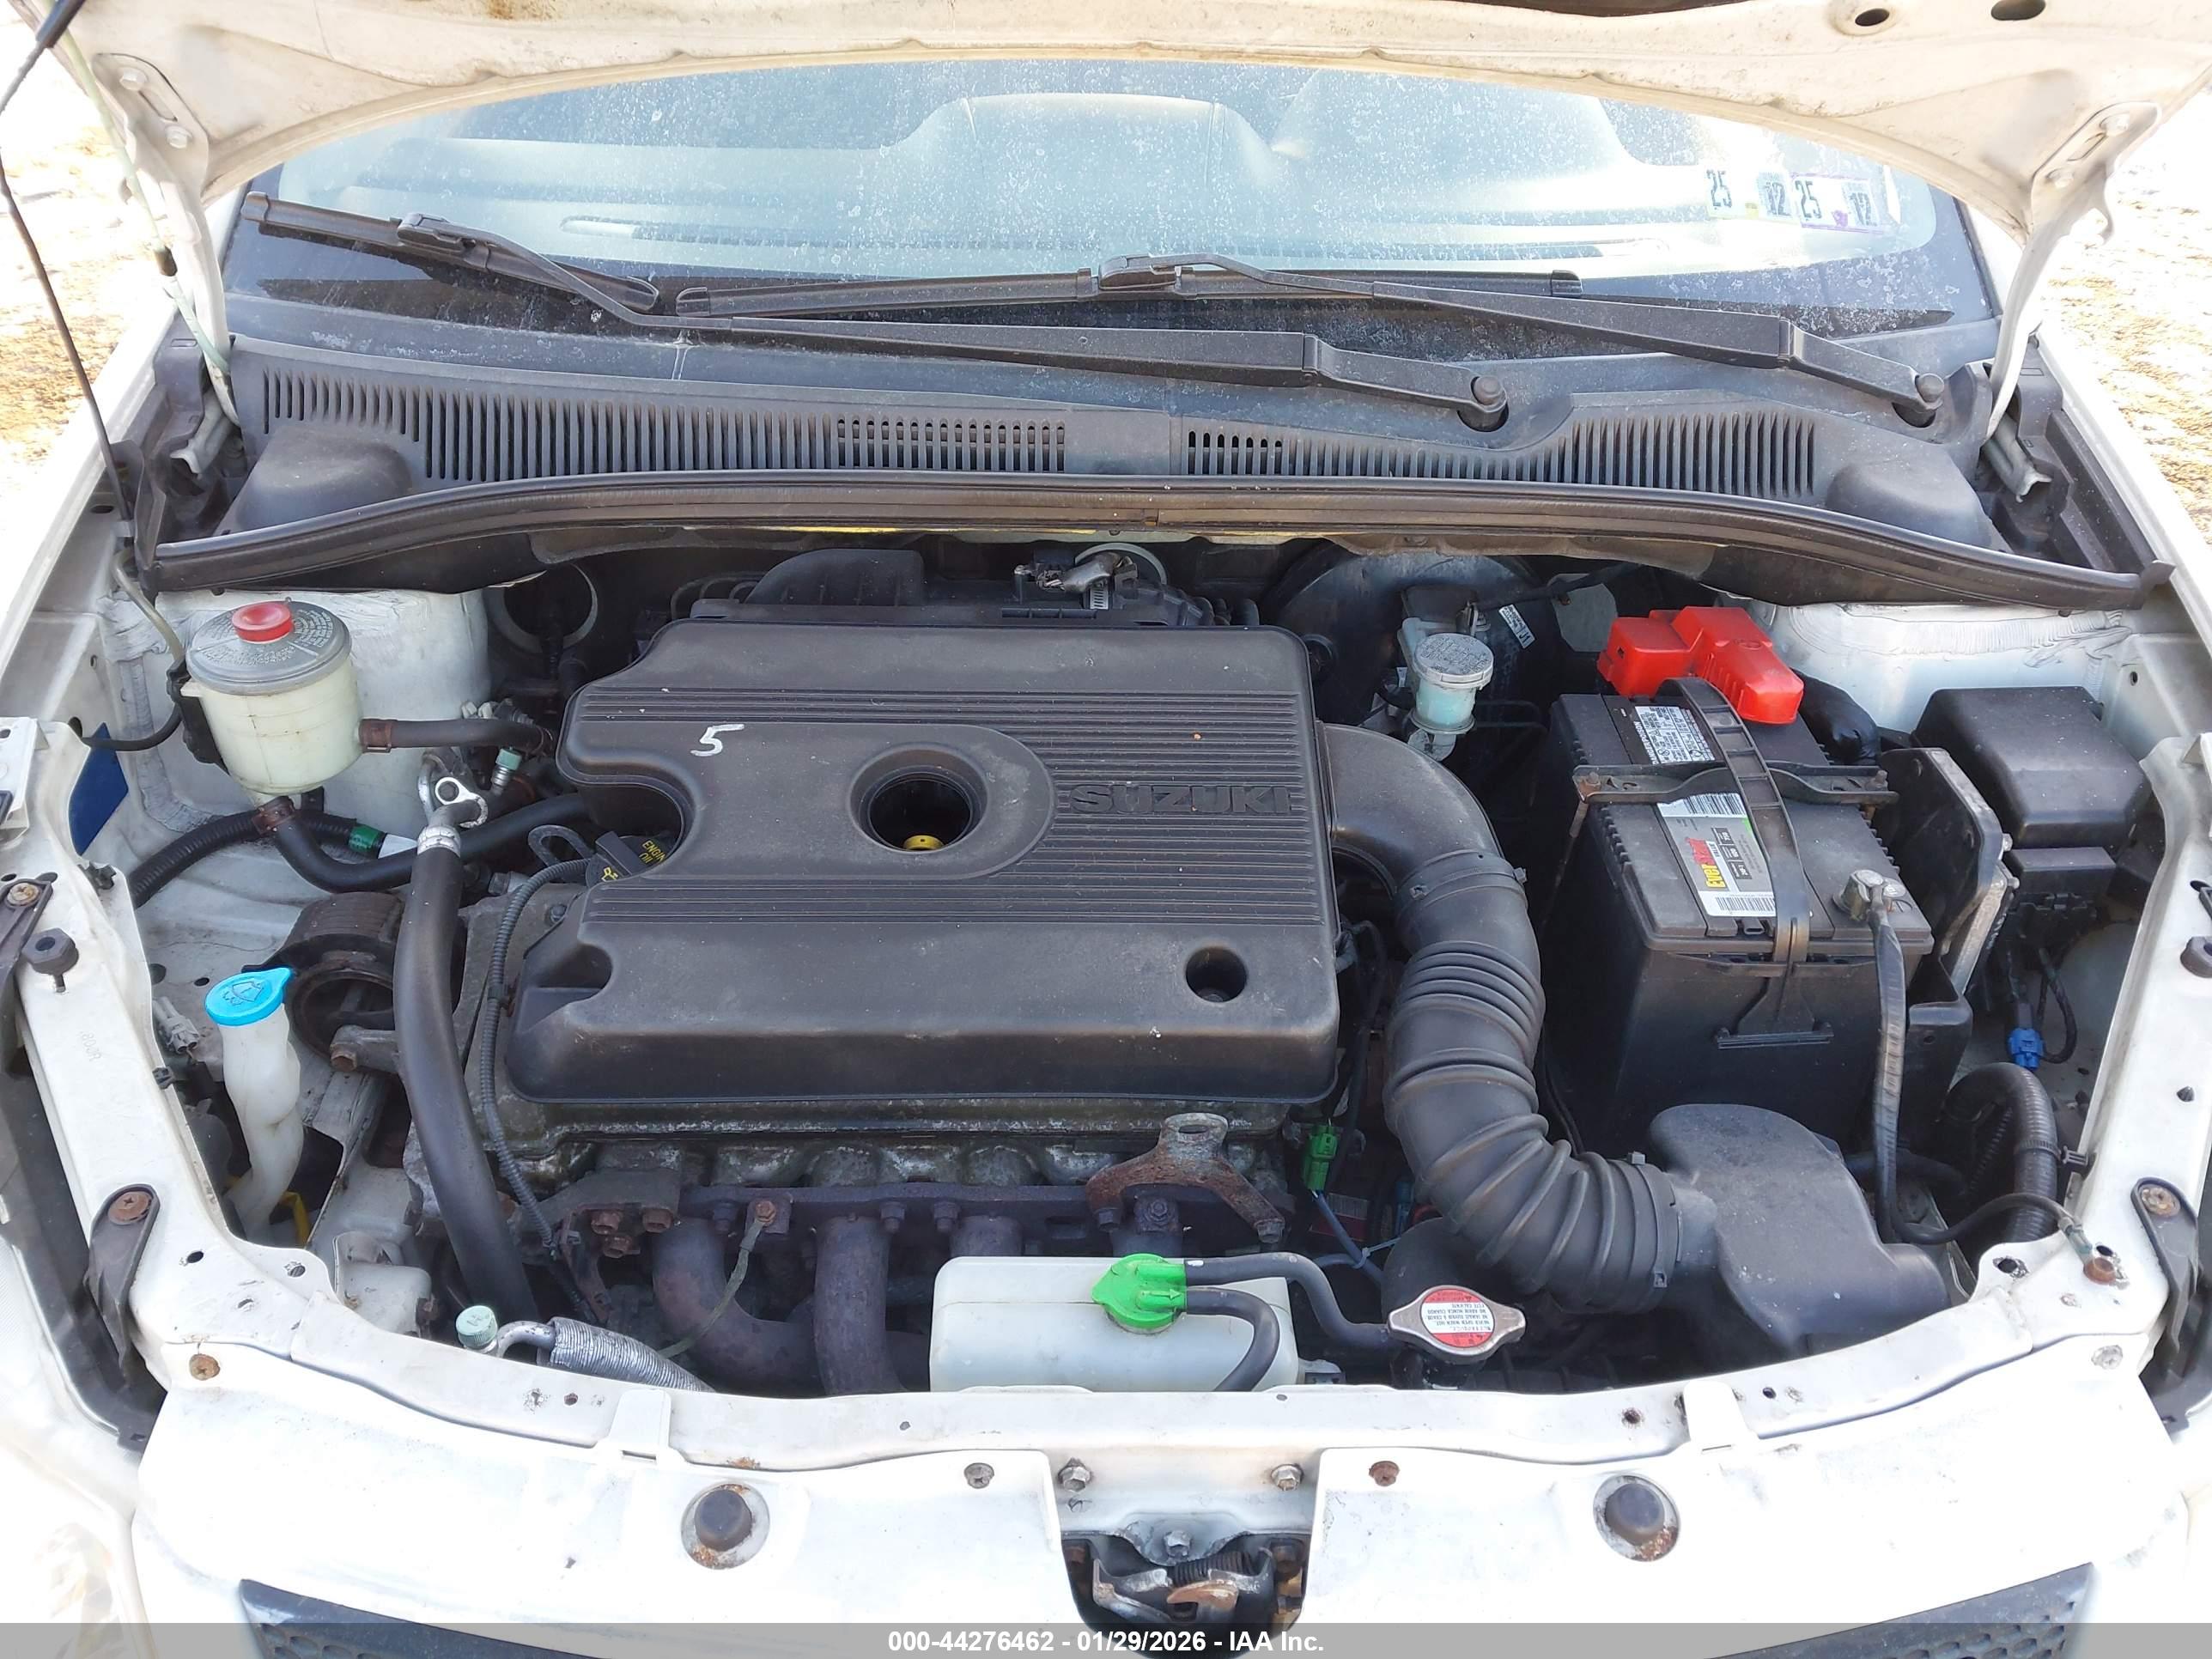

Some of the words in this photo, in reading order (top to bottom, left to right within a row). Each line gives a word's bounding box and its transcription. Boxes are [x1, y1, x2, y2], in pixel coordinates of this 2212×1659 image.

[1706, 169, 1733, 208] 25
[1795, 180, 1822, 219] 25
[690, 723, 745, 757] 5
[1073, 784, 1289, 813] SUZUKI
[641, 840, 666, 862] ENGIN
